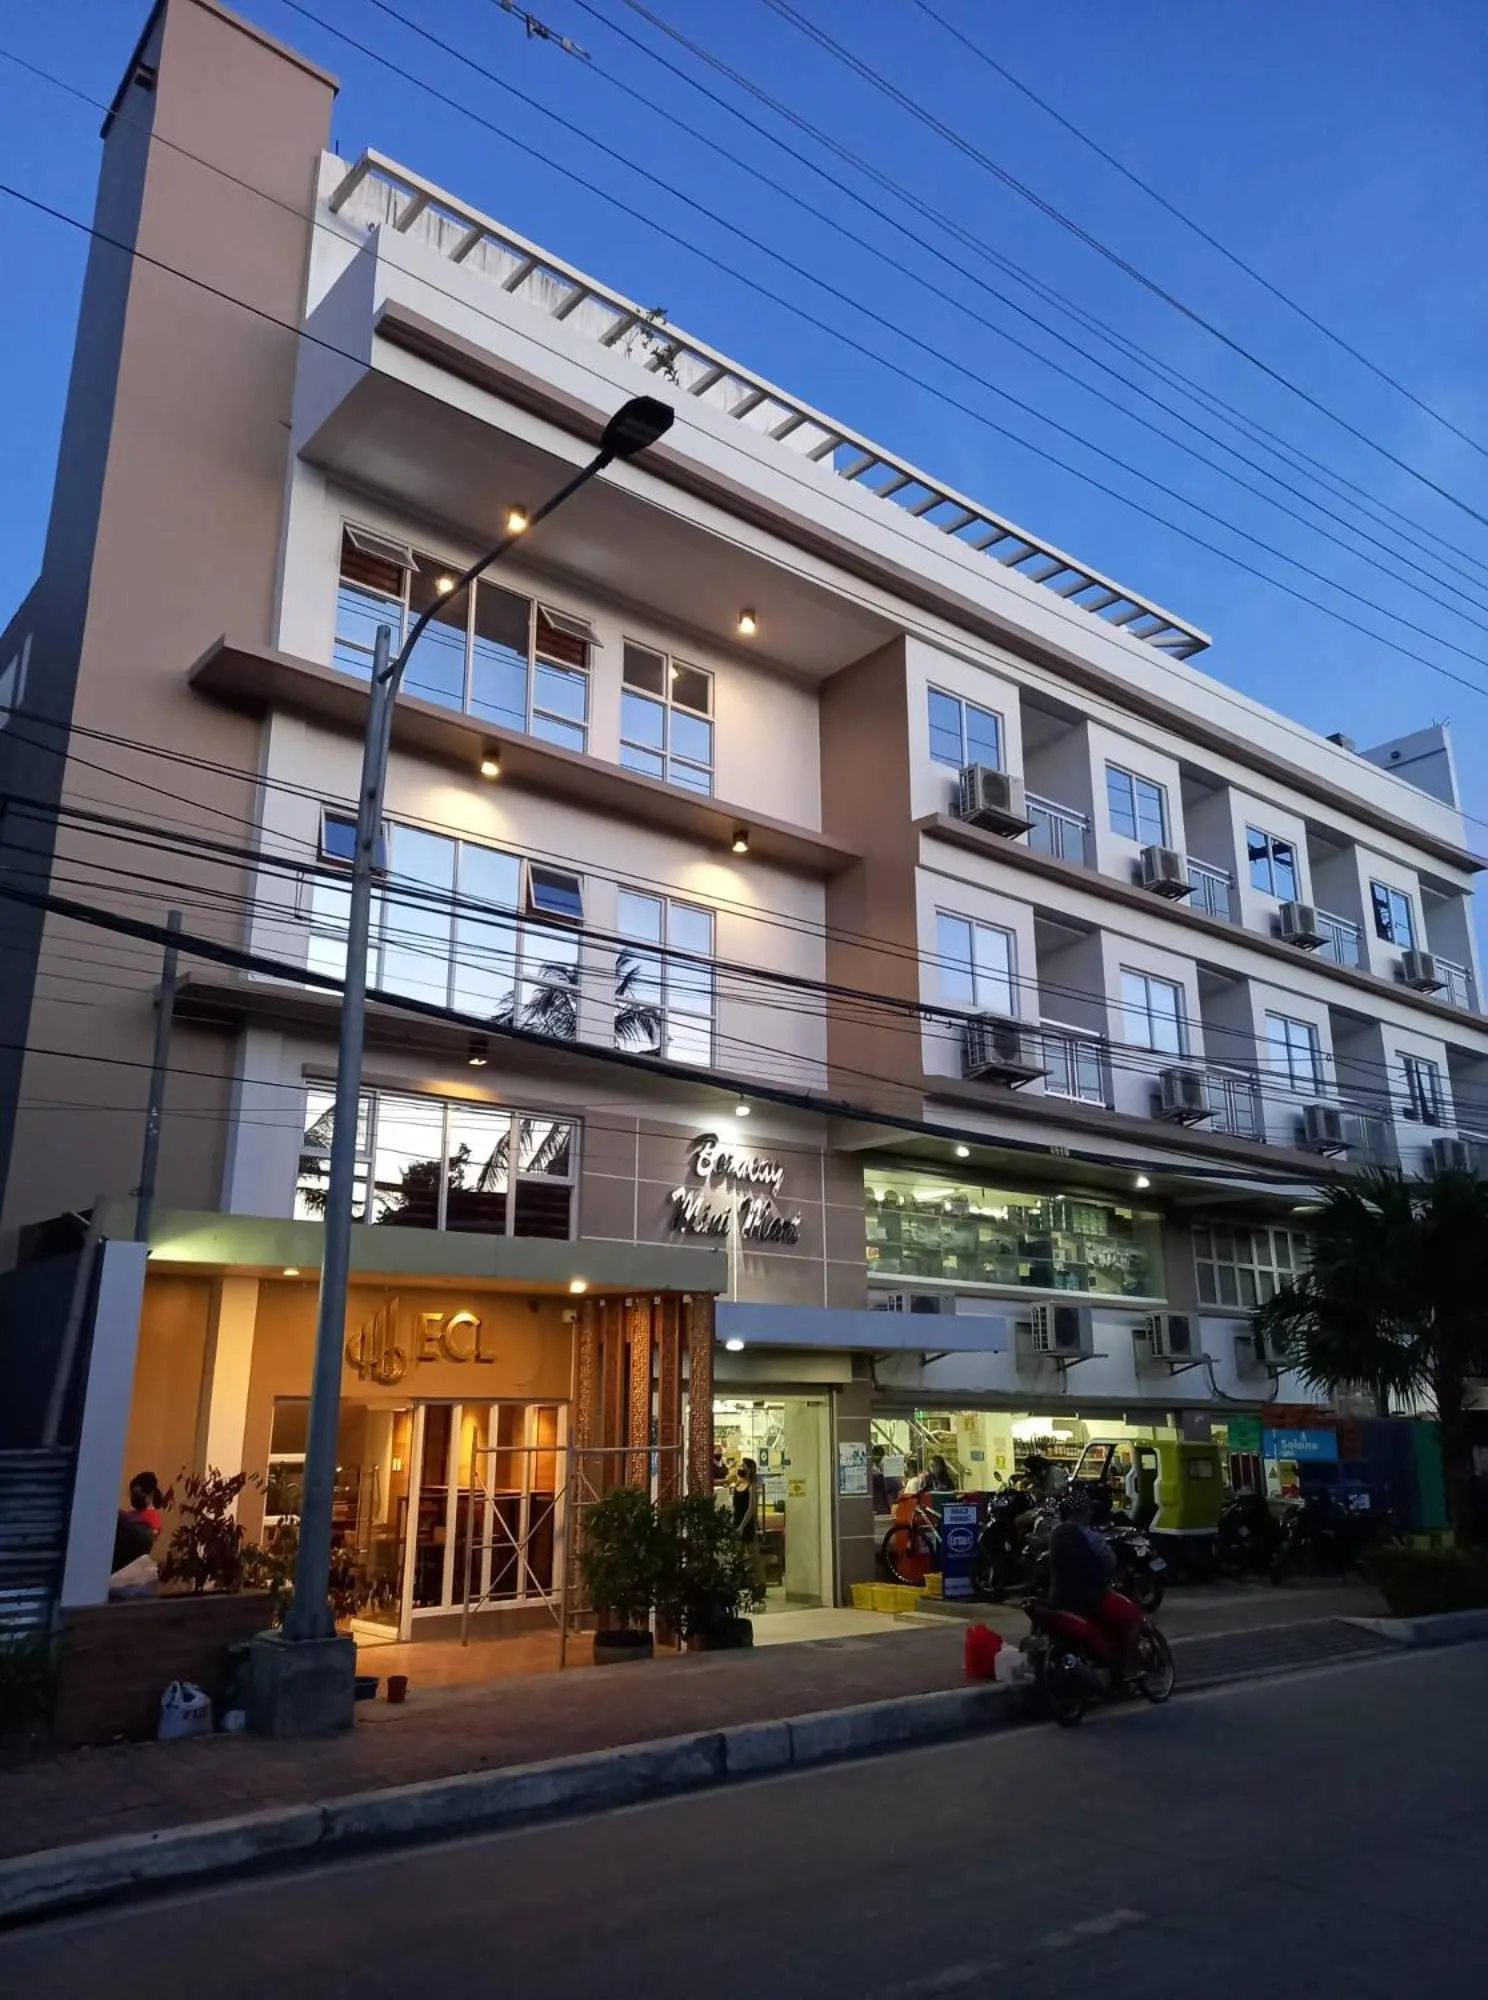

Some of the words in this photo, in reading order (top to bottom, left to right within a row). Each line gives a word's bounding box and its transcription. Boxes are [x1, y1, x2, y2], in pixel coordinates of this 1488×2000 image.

[671, 1186, 731, 1234] Mini
[739, 1194, 801, 1244] Mart
[416, 1309, 494, 1365] ECL
[1280, 1438, 1319, 1451] Solane
